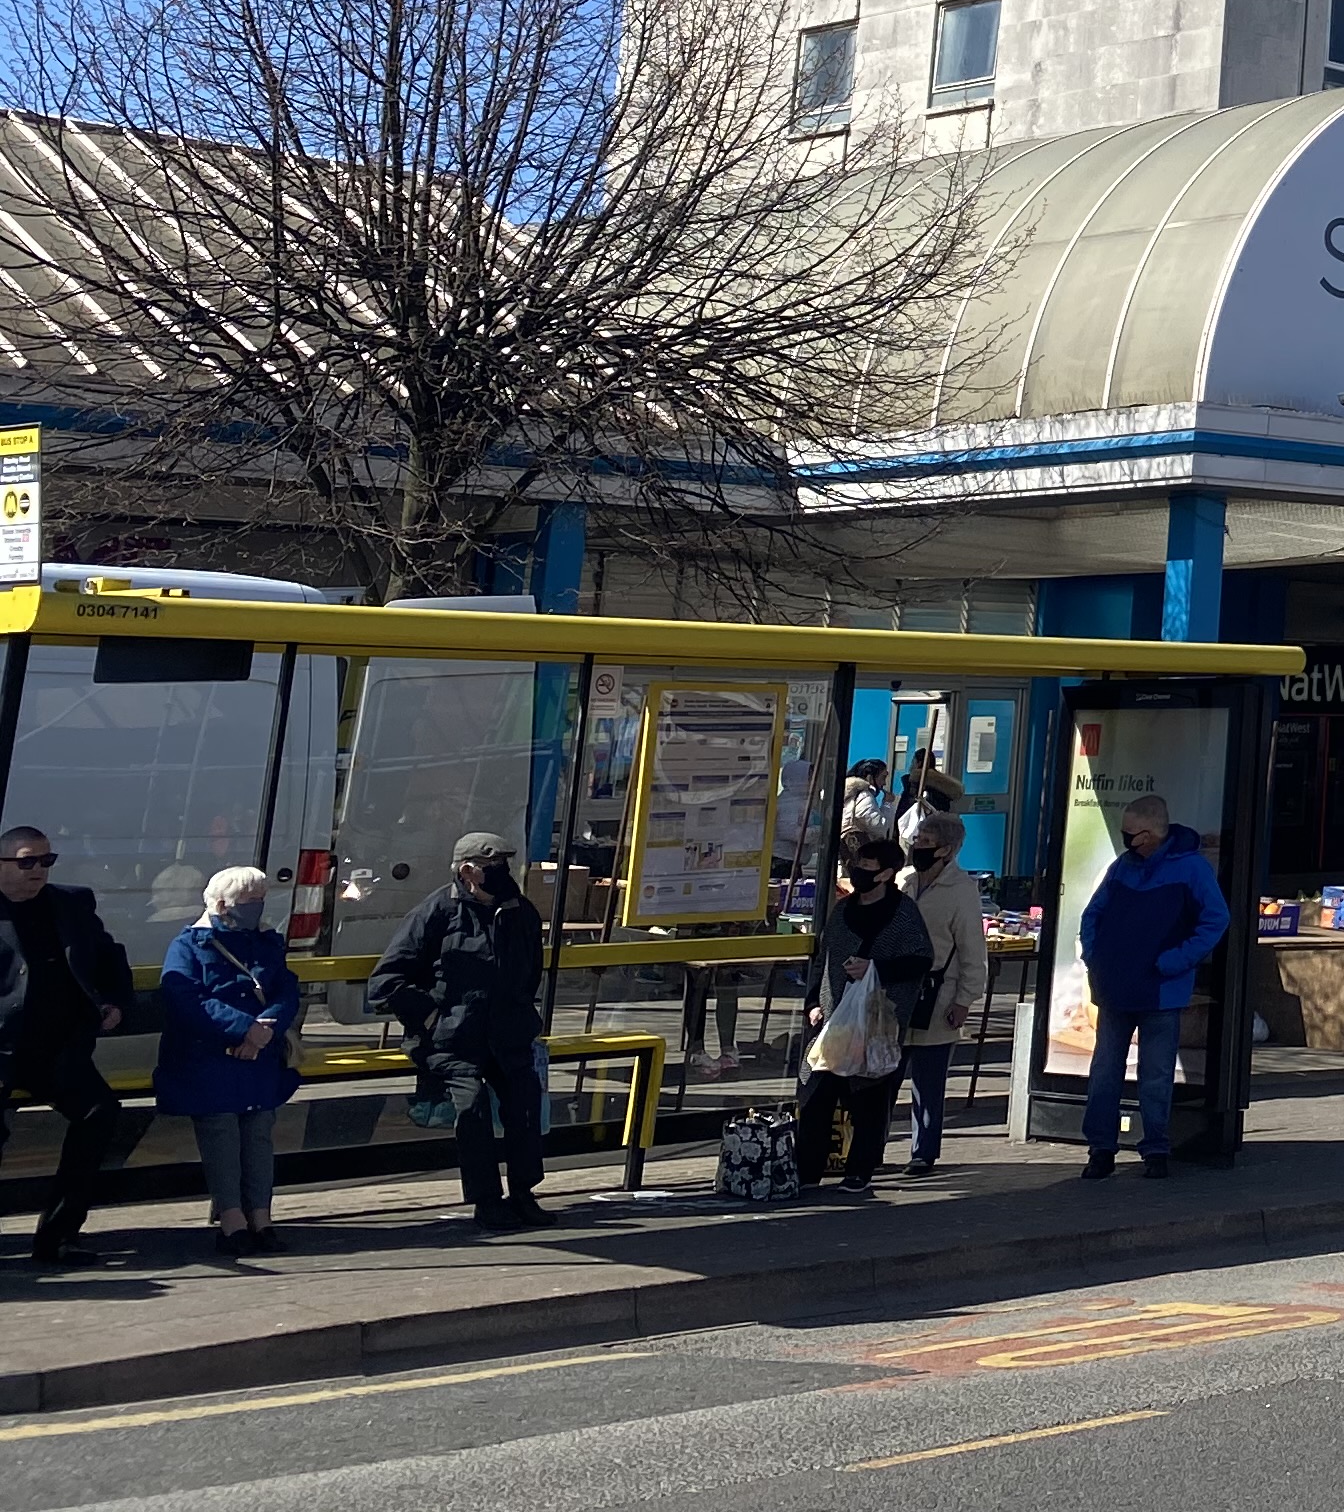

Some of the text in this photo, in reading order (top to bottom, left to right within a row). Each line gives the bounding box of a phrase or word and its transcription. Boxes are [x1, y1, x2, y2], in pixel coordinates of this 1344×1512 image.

[77, 604, 159, 620] 0304 7141
[1075, 774, 1155, 793] Nuffin like it
